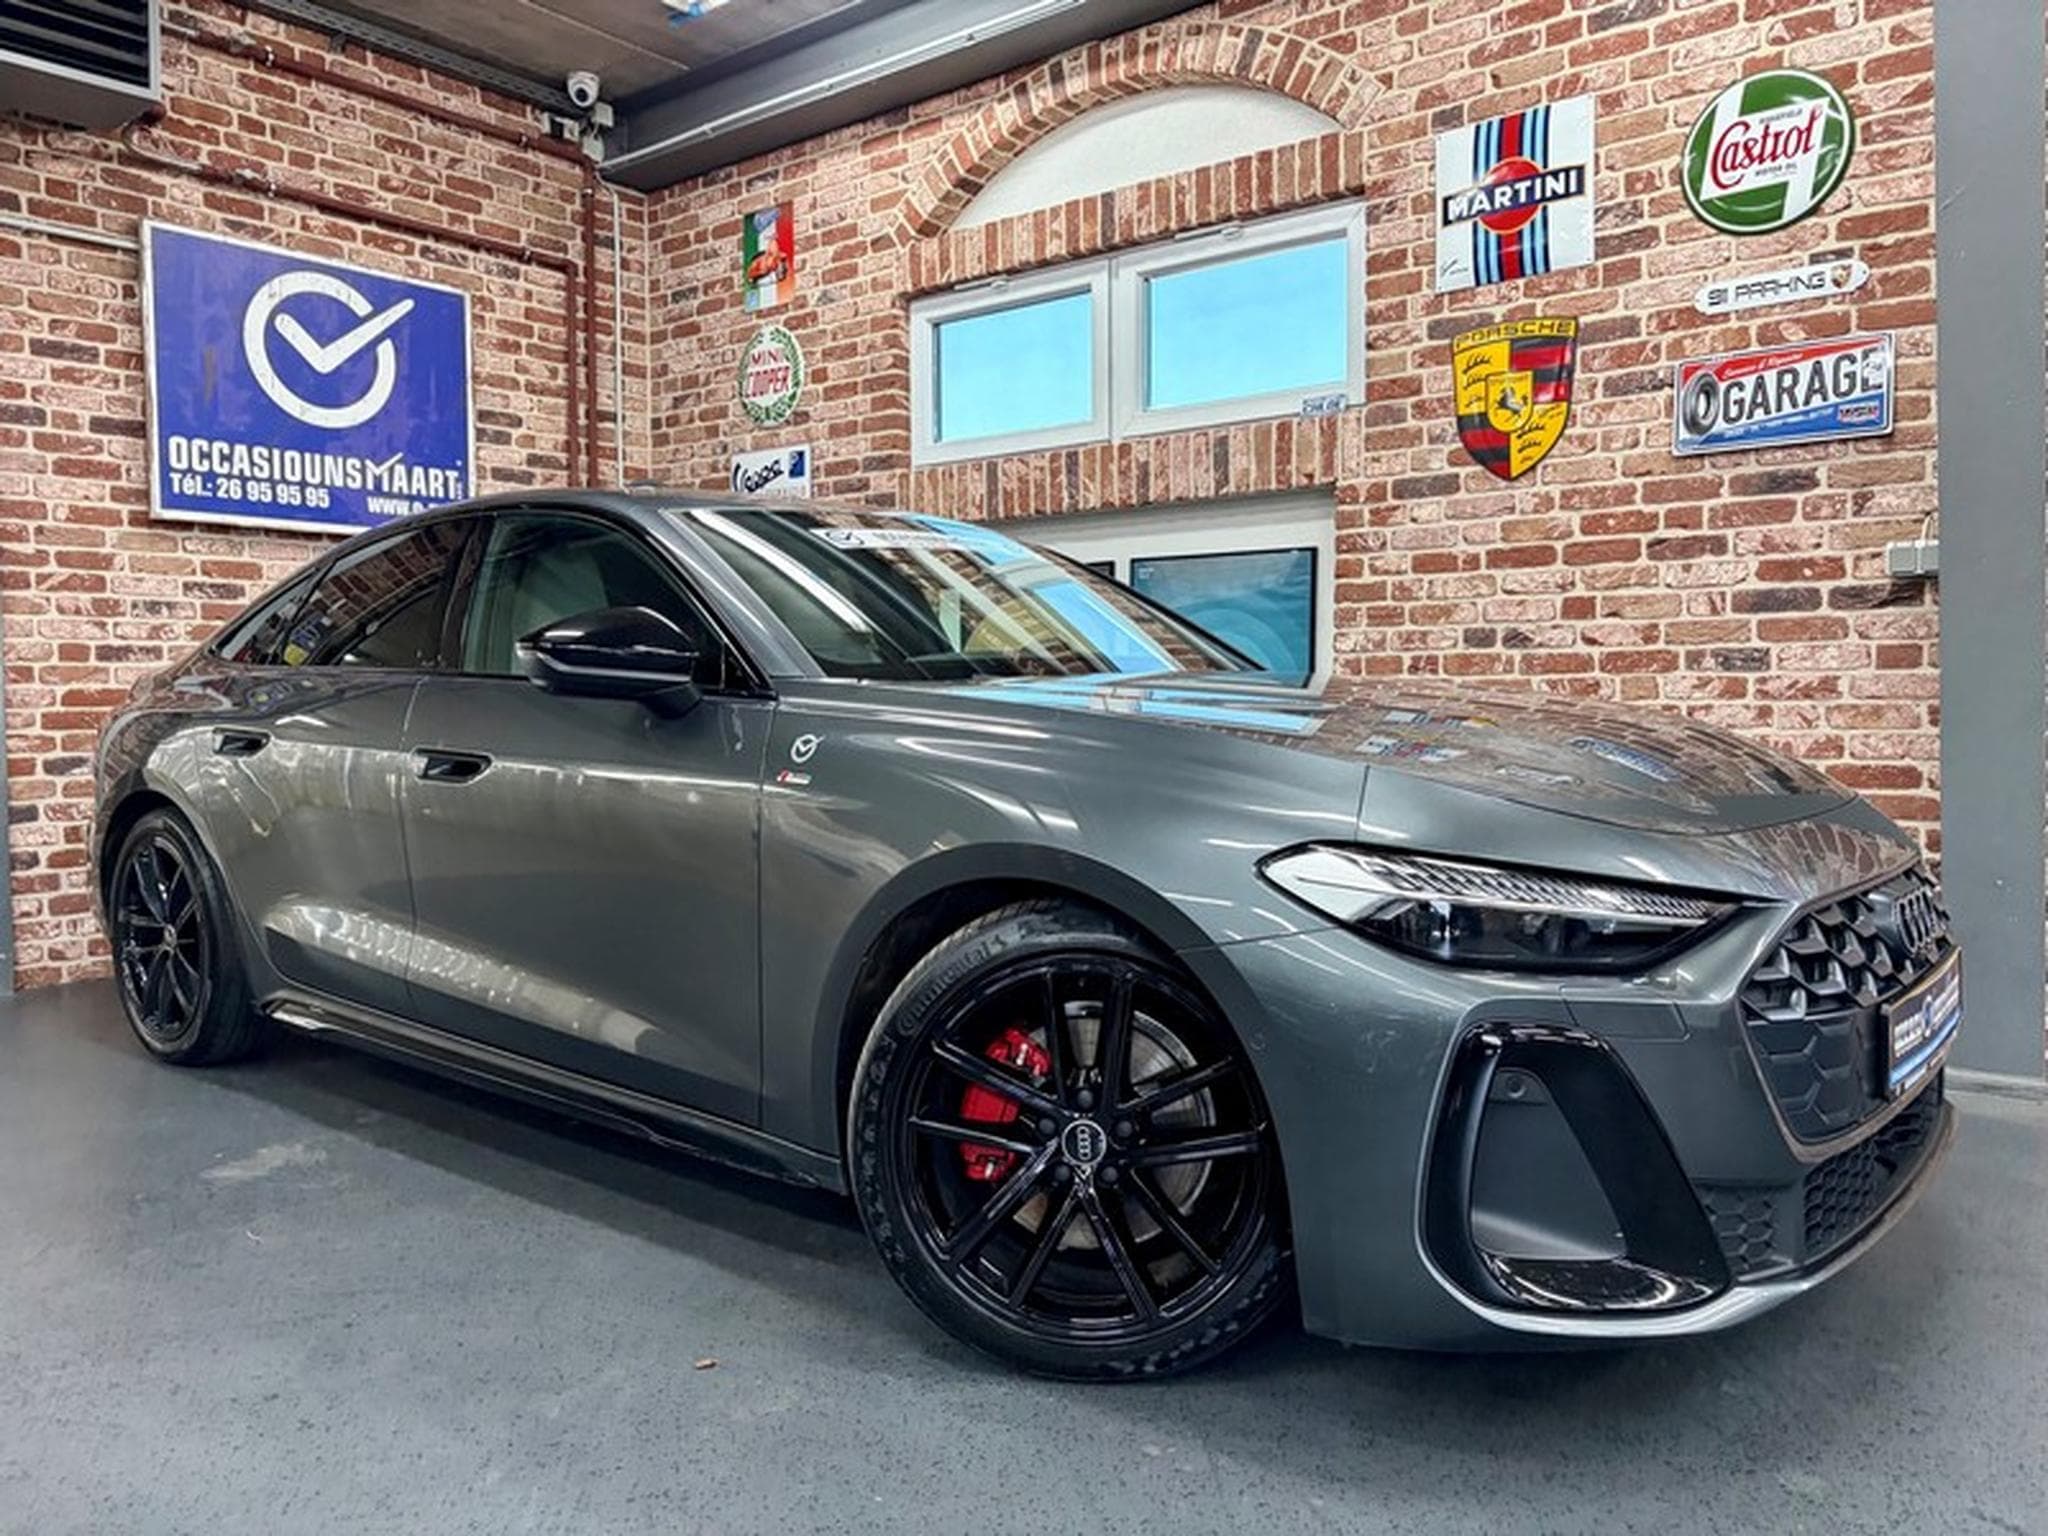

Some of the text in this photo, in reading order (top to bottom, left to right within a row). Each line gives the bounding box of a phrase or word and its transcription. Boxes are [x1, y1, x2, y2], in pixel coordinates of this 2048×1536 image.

[1711, 104, 1823, 190] Castrol
[1447, 169, 1579, 222] MARTINI
[1735, 271, 1826, 300] PARKING
[1456, 321, 1573, 349] PORSCHE
[1722, 346, 1884, 425] GARAGE
[168, 471, 331, 509] Tél.: 26 95 95 95
